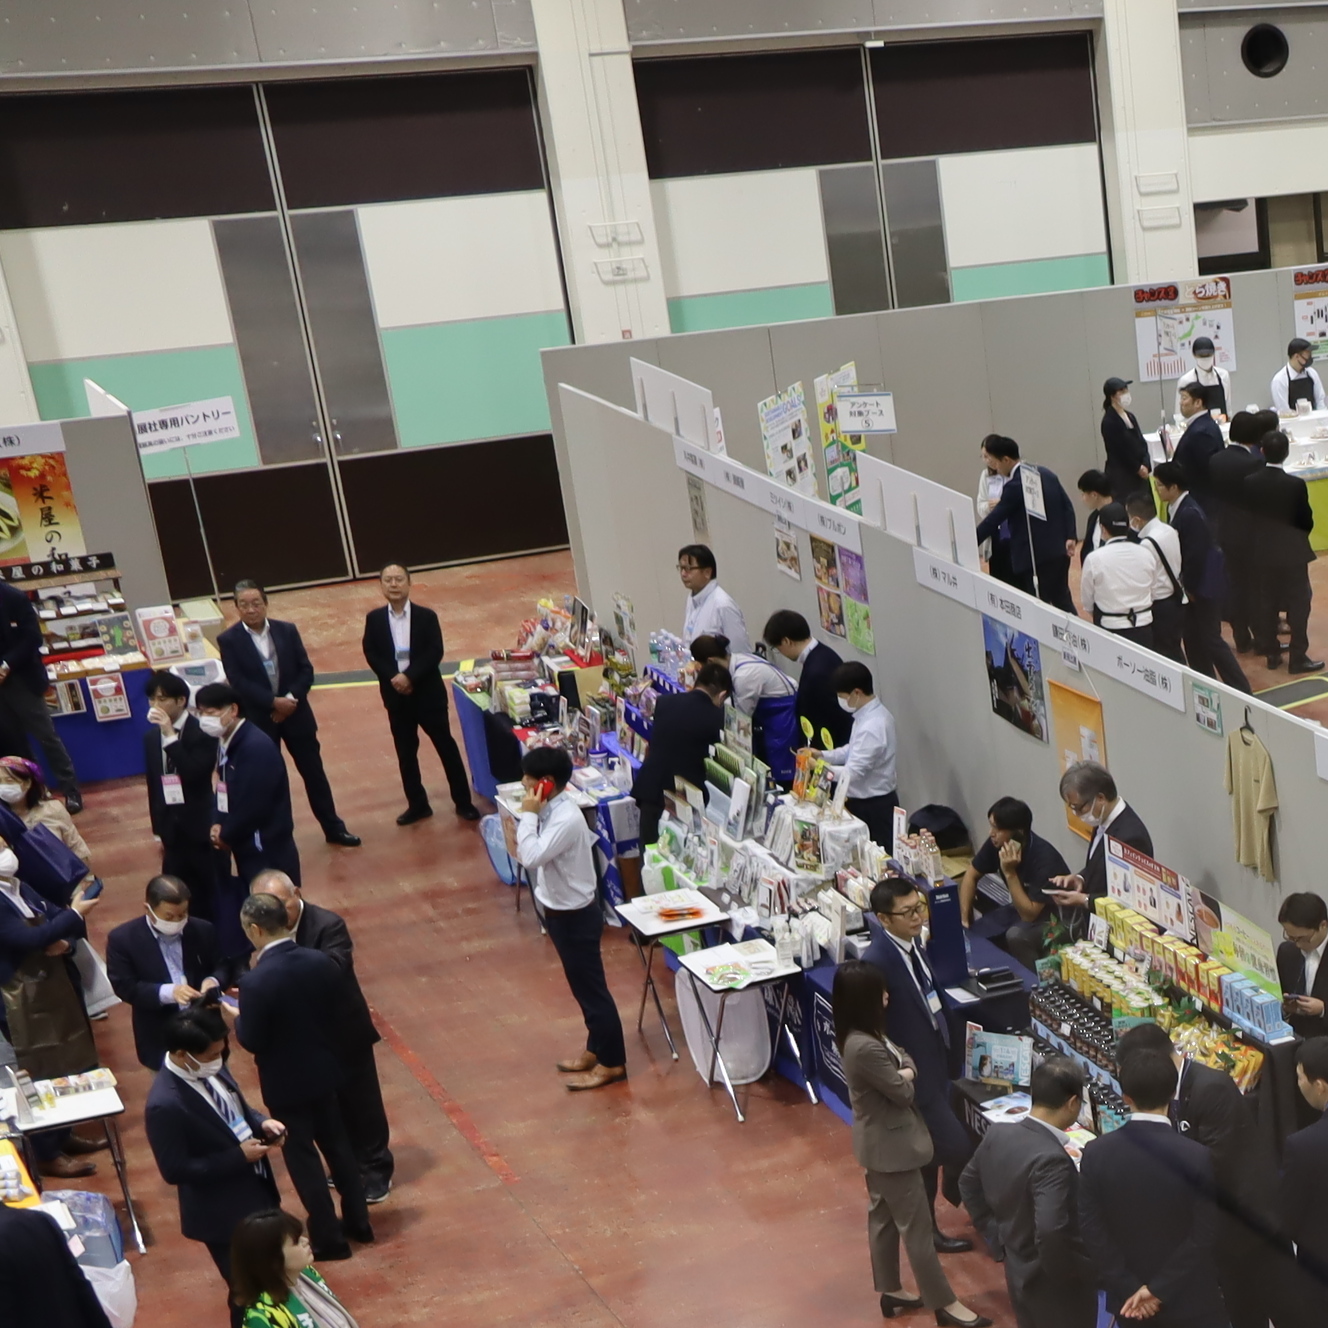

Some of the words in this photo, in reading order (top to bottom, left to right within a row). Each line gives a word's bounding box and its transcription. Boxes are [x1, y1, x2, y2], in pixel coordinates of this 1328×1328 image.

[850, 400, 881, 409] アンケート
